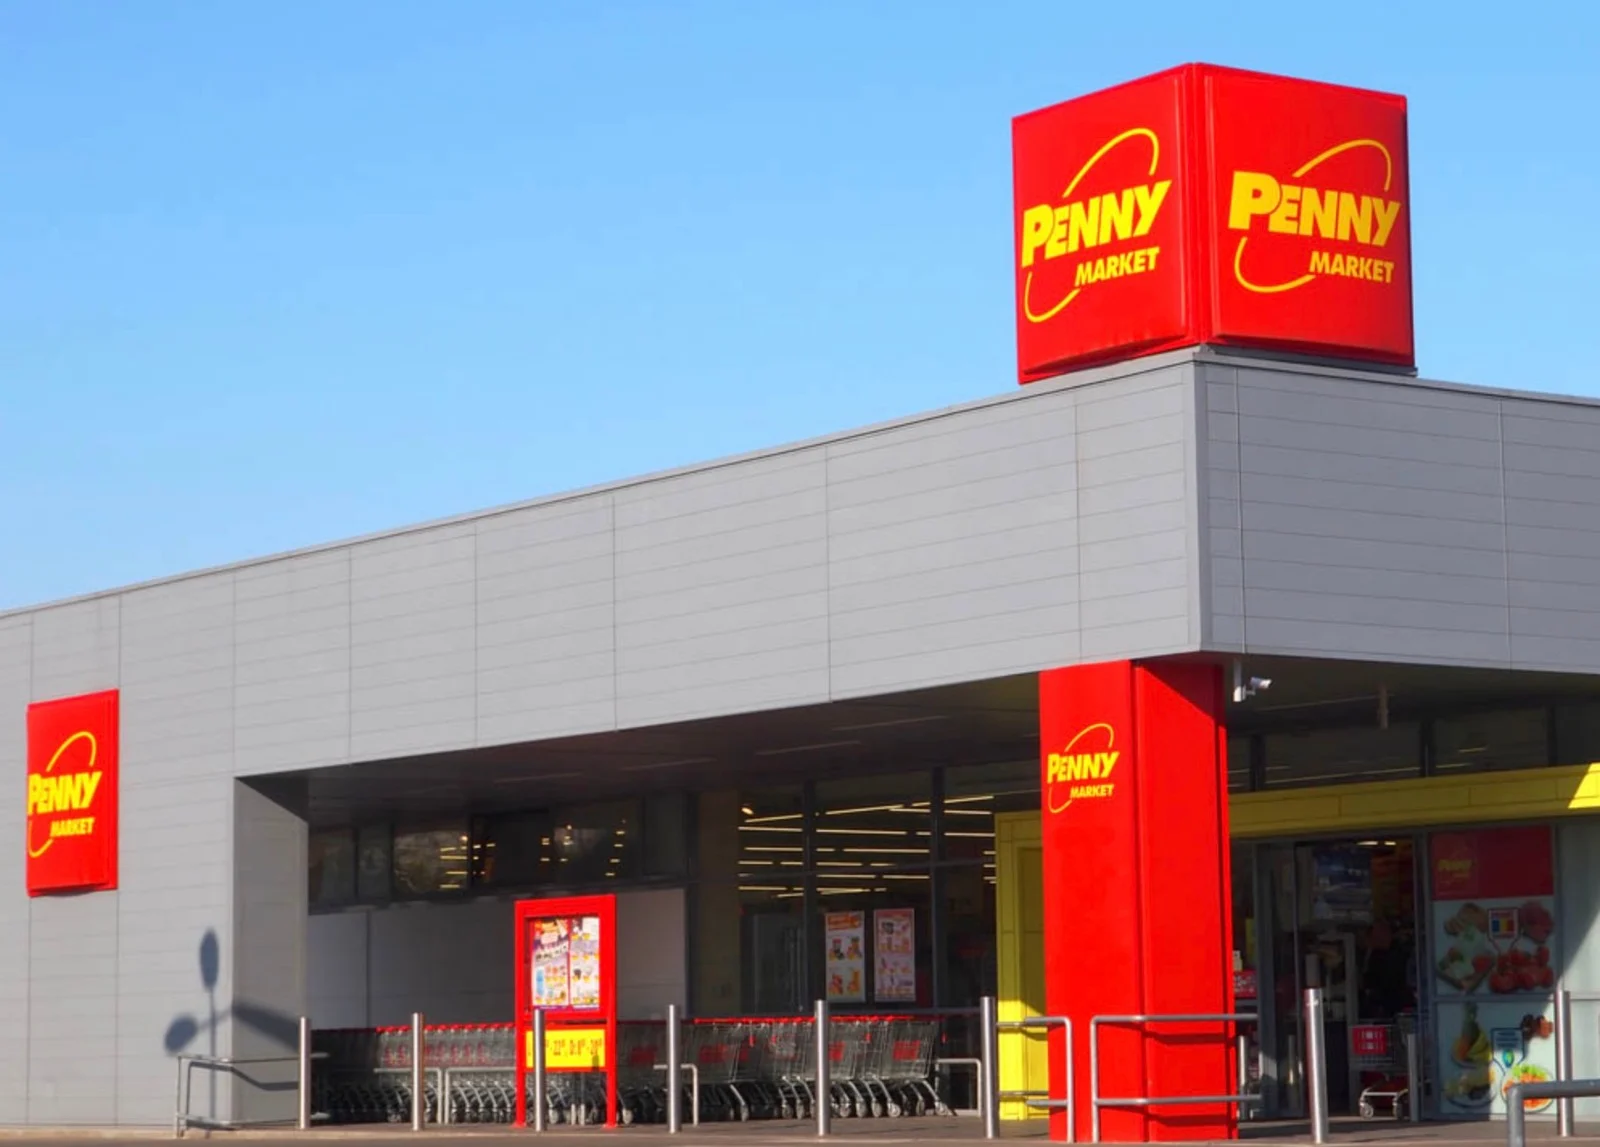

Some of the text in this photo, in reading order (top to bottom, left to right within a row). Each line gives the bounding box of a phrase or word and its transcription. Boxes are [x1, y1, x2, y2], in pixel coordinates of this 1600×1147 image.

[1022, 181, 1171, 267] PENNY
[1229, 171, 1401, 247] PENNY
[1075, 247, 1159, 287] MARKET
[1309, 252, 1394, 283] MARKET
[1048, 751, 1119, 784] PENNY
[27, 771, 102, 815] PENNY
[1070, 784, 1114, 799] MARKET
